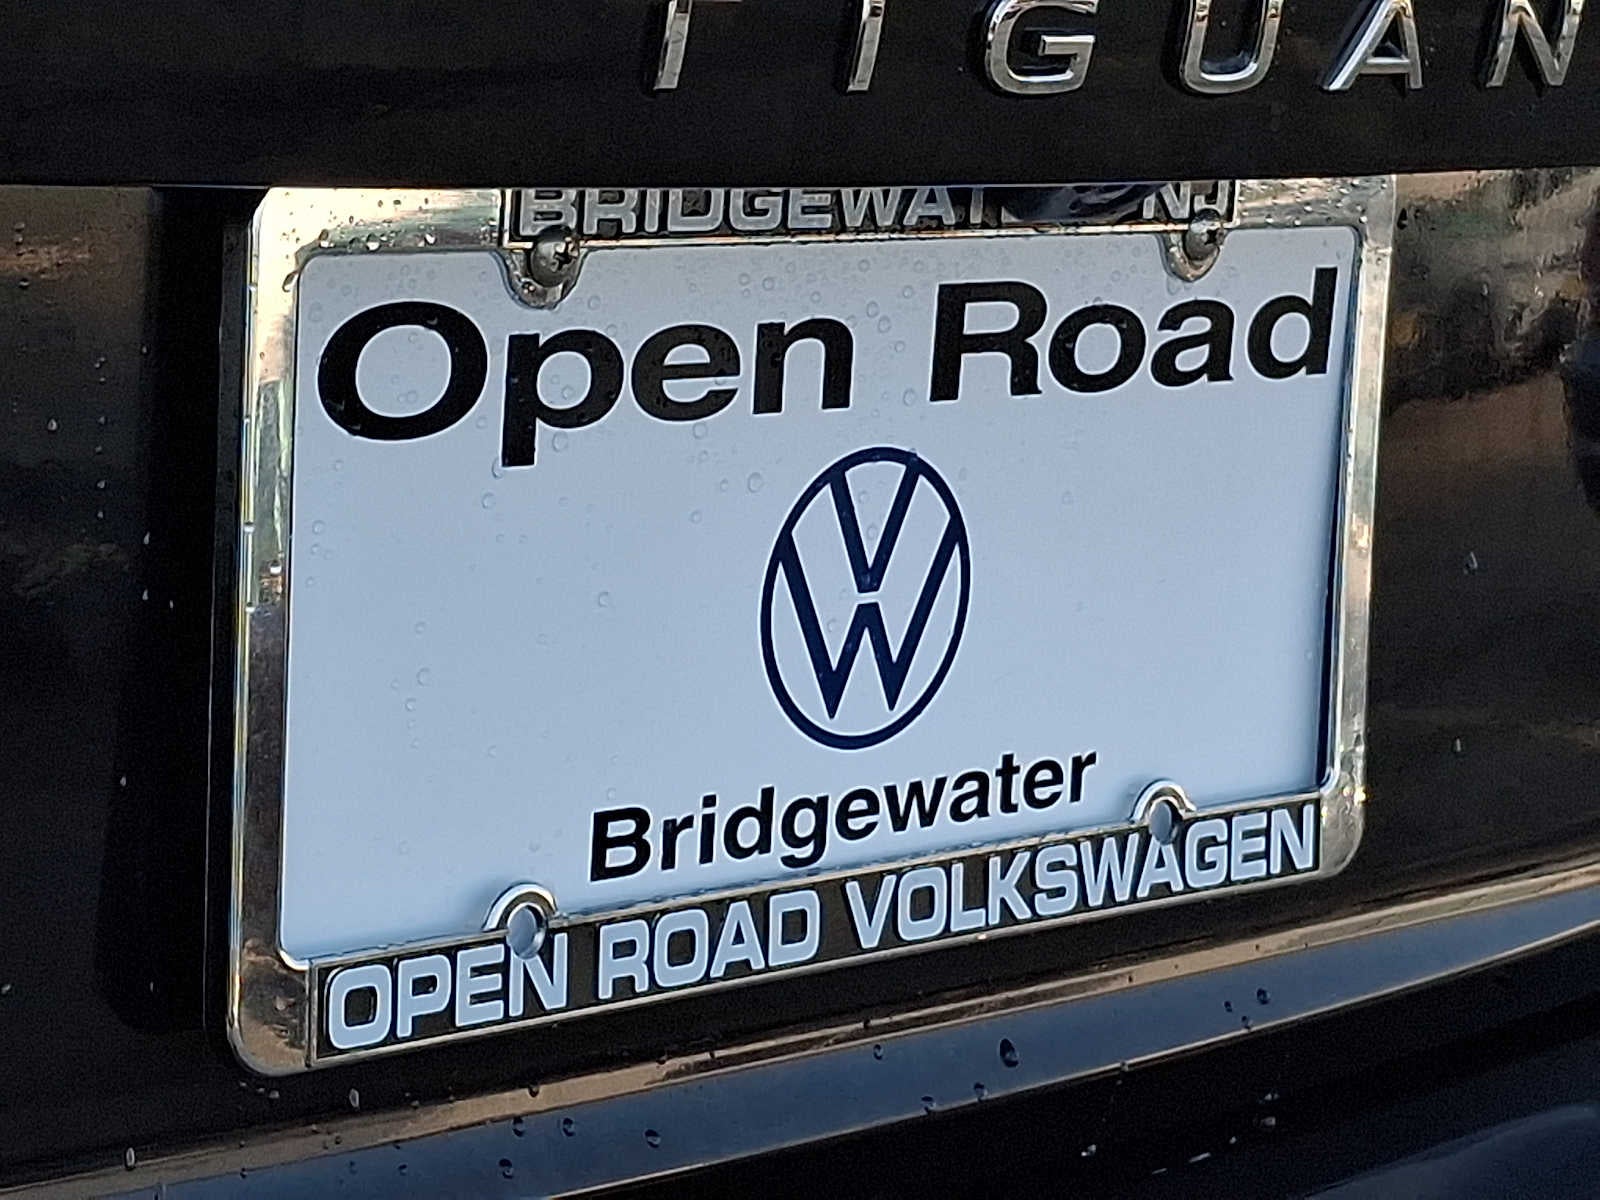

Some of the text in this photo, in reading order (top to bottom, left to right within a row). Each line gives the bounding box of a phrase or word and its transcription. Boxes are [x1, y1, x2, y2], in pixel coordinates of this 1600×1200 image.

[318, 268, 1338, 466] Open Road
[590, 752, 1096, 881] Bridgewater
[328, 805, 1315, 1050] OPEN ROAD VOLKSWAGEN
